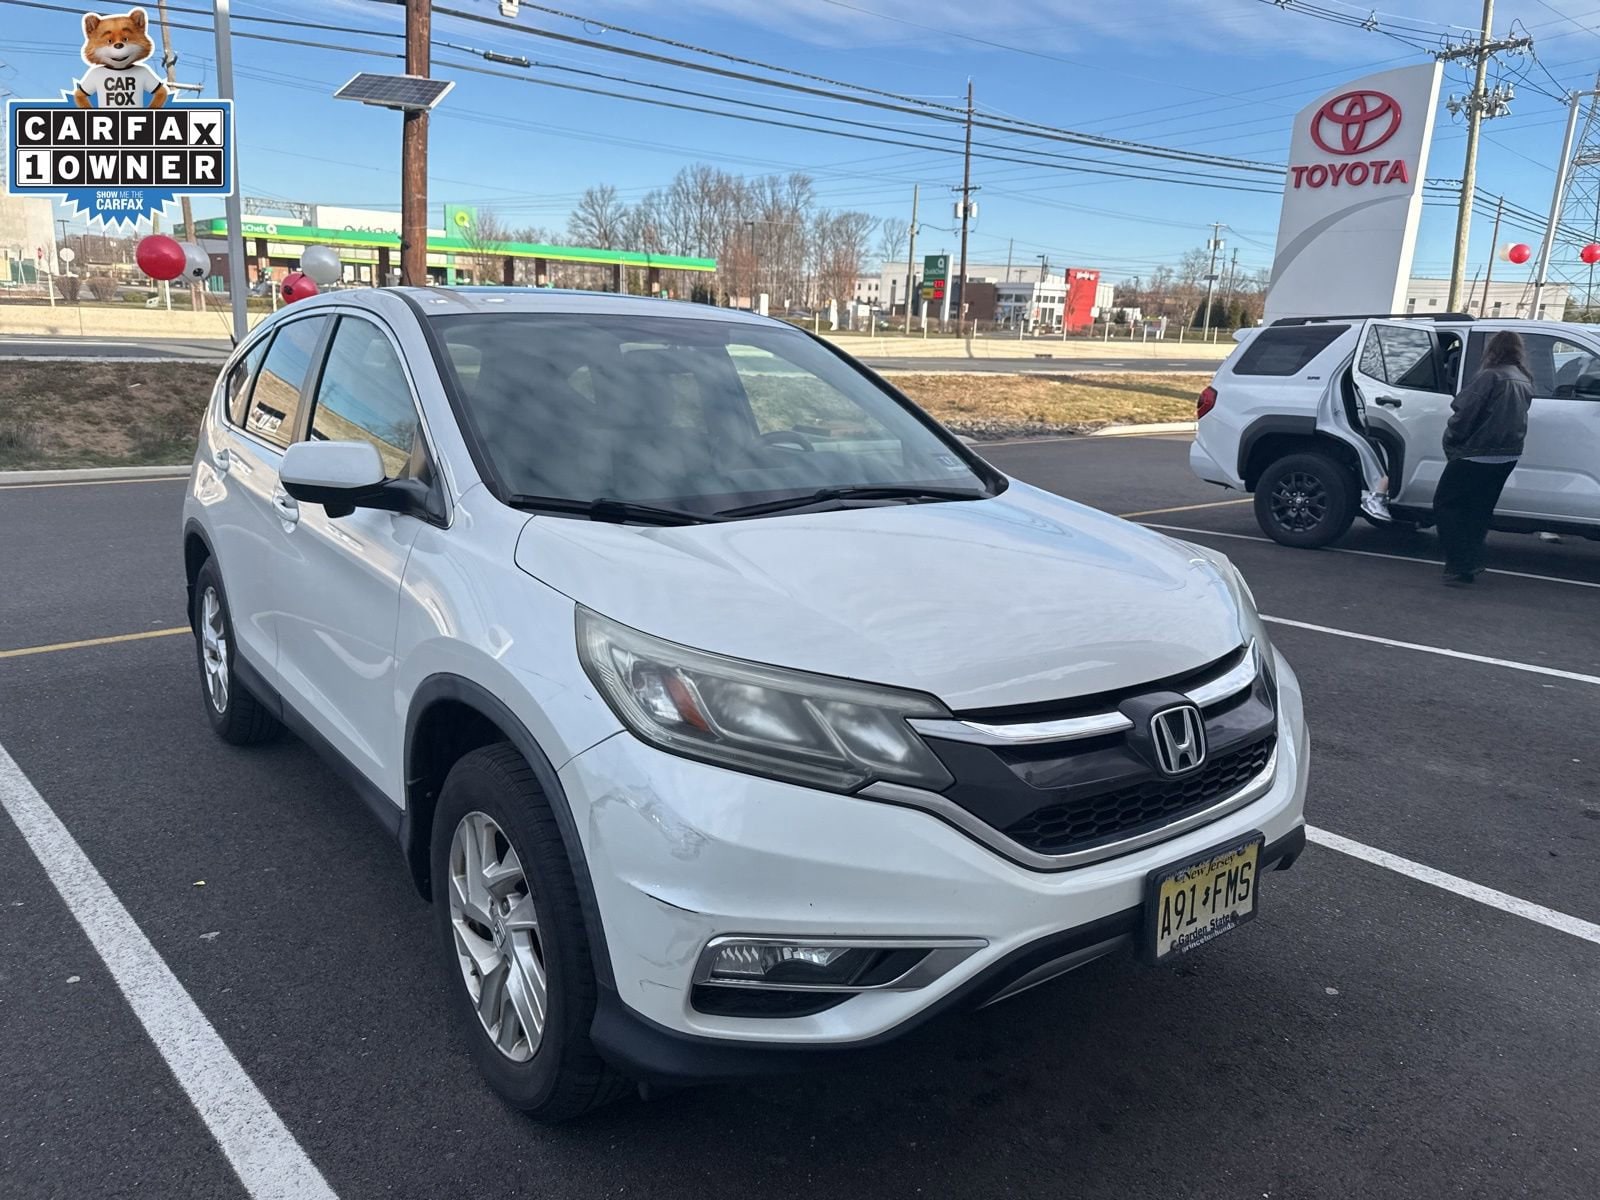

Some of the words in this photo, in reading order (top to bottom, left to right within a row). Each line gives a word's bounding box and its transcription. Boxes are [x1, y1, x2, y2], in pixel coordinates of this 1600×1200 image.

[1291, 159, 1409, 188] TOYOTA
[1181, 865, 1207, 883] New
[1205, 855, 1235, 876] Jersey
[1178, 926, 1208, 945] Garden
[1209, 914, 1231, 932] State
